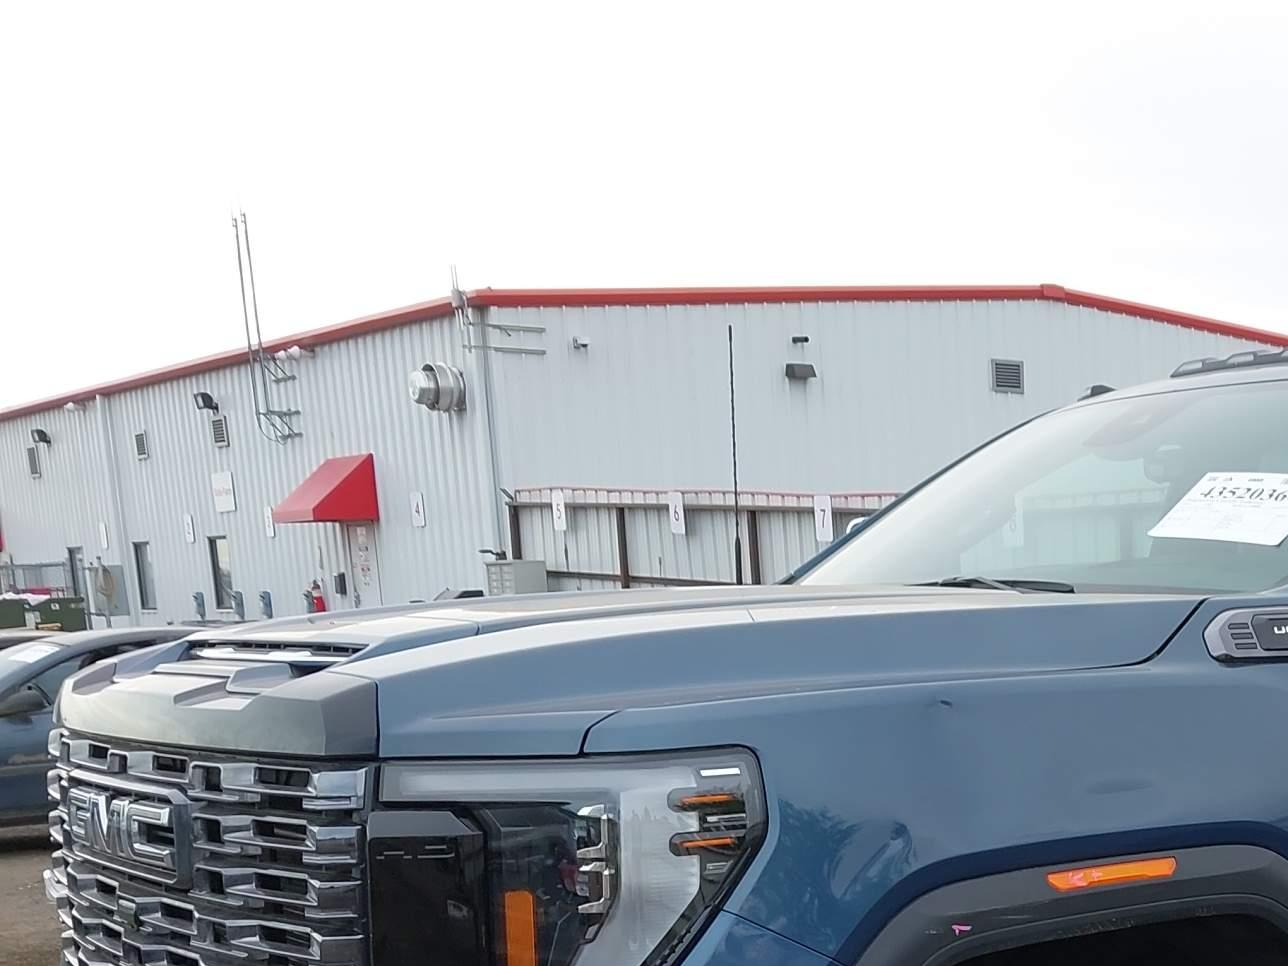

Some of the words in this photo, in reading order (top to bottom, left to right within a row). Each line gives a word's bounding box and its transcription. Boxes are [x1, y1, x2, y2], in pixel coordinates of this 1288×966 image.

[414, 500, 421, 517] 4
[556, 507, 562, 520] 5
[673, 507, 680, 522] 6
[819, 508, 827, 528] 7
[67, 786, 172, 868] GMC
